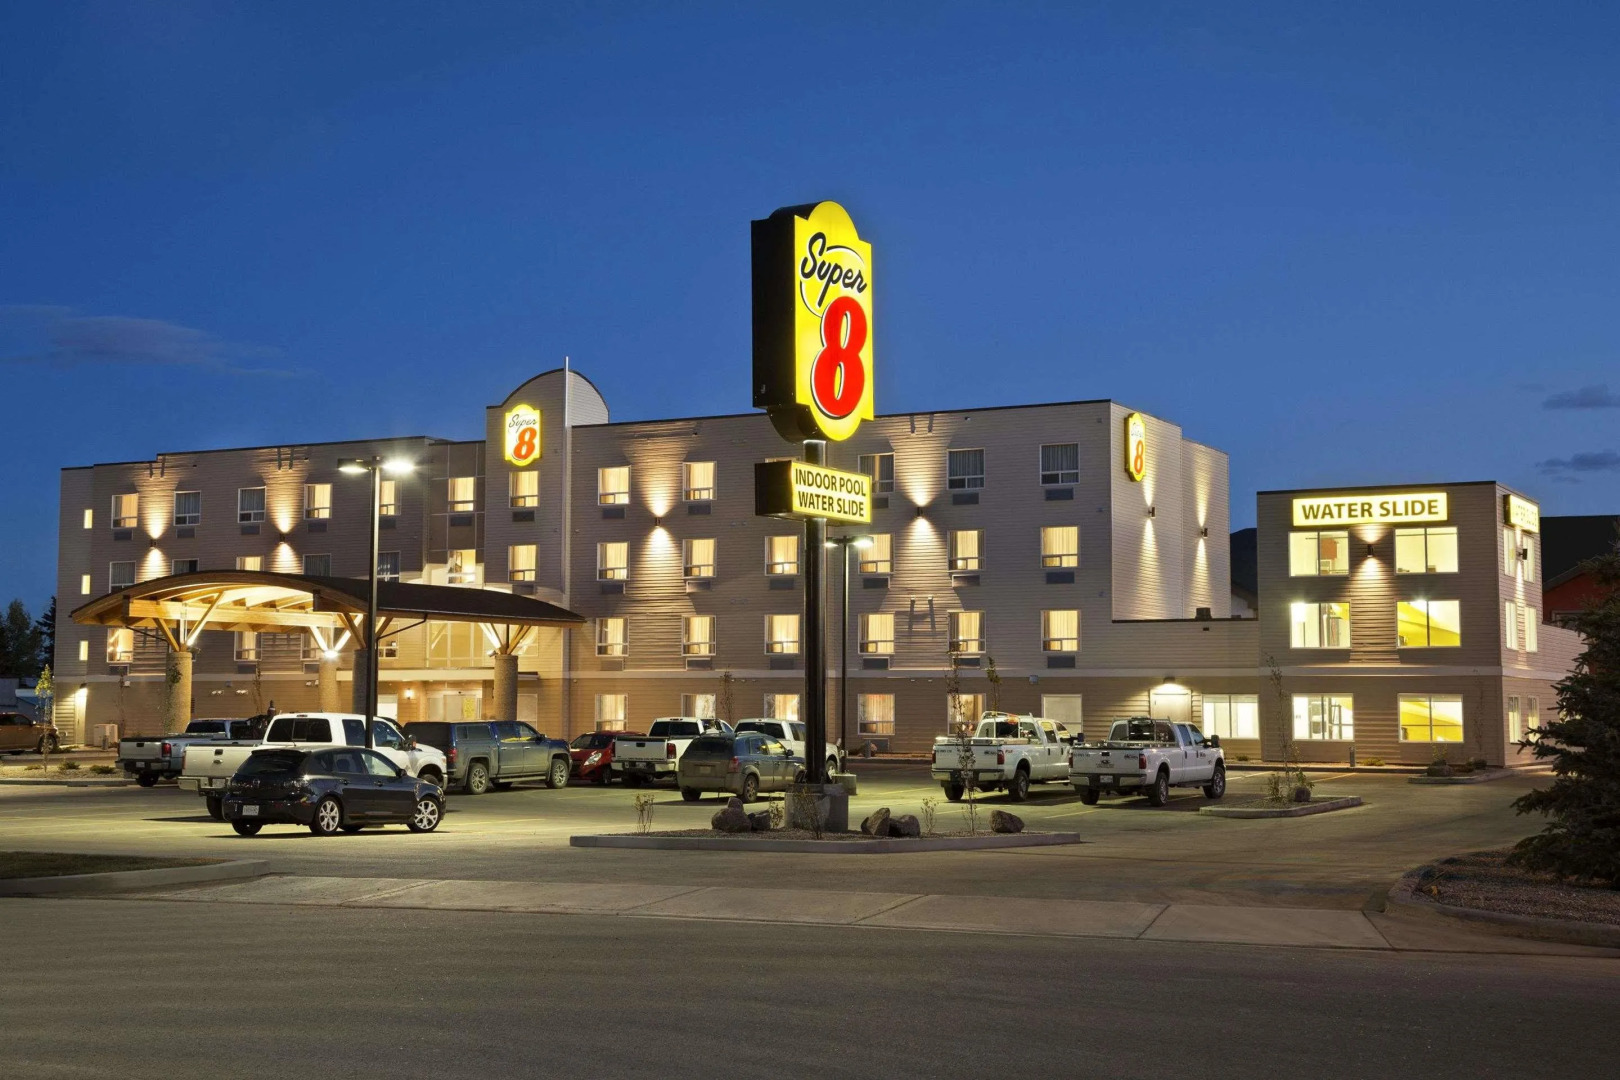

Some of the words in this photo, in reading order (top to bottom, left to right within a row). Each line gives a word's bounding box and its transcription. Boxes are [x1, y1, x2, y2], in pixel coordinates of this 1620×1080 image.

[801, 232, 867, 308] Super
[811, 296, 868, 419] 8
[508, 413, 538, 433] Super
[512, 427, 537, 461] 8
[795, 468, 837, 491] INDOOR
[839, 476, 866, 497] POOL
[798, 491, 835, 512] WATER
[837, 498, 864, 517] SLIDE
[1302, 502, 1373, 520] WATER
[1379, 499, 1439, 517] SLIDE
